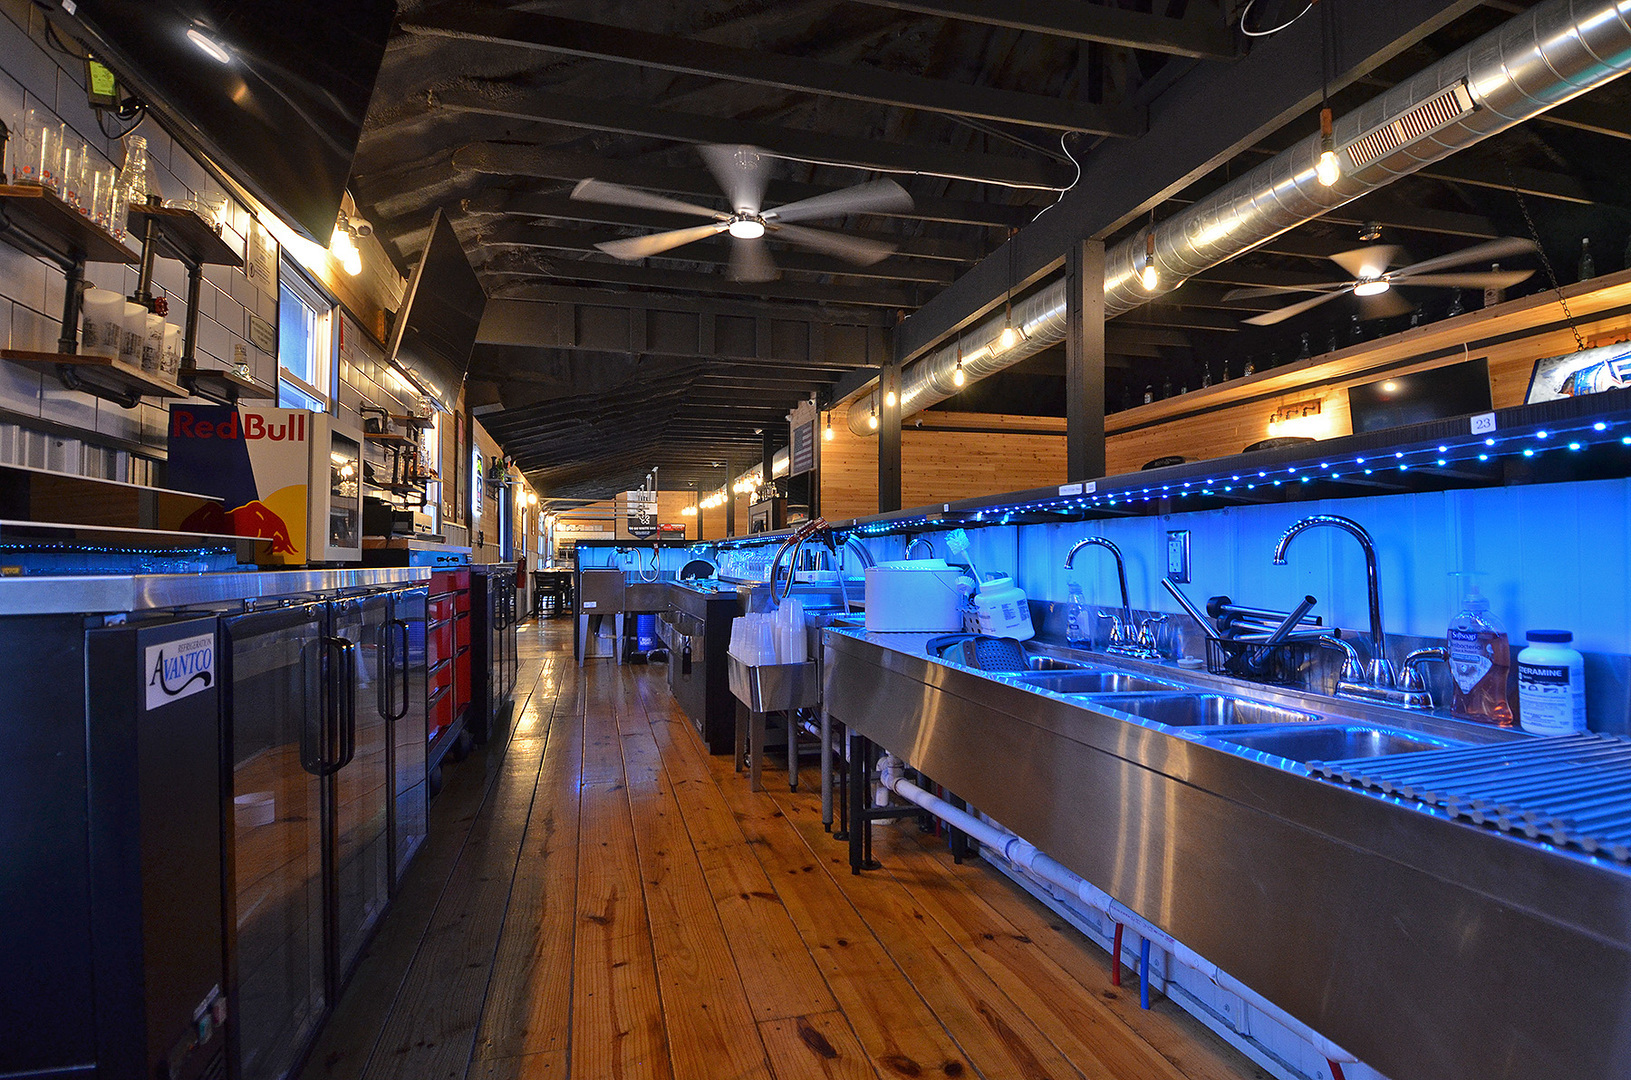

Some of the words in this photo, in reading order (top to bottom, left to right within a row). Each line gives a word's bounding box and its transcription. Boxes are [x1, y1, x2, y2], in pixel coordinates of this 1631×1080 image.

[173, 411, 237, 439] Red
[244, 413, 305, 442] Bull
[1476, 418, 1491, 430] 23
[1452, 631, 1477, 641] Softsoap
[149, 647, 212, 694] AVANTCO
